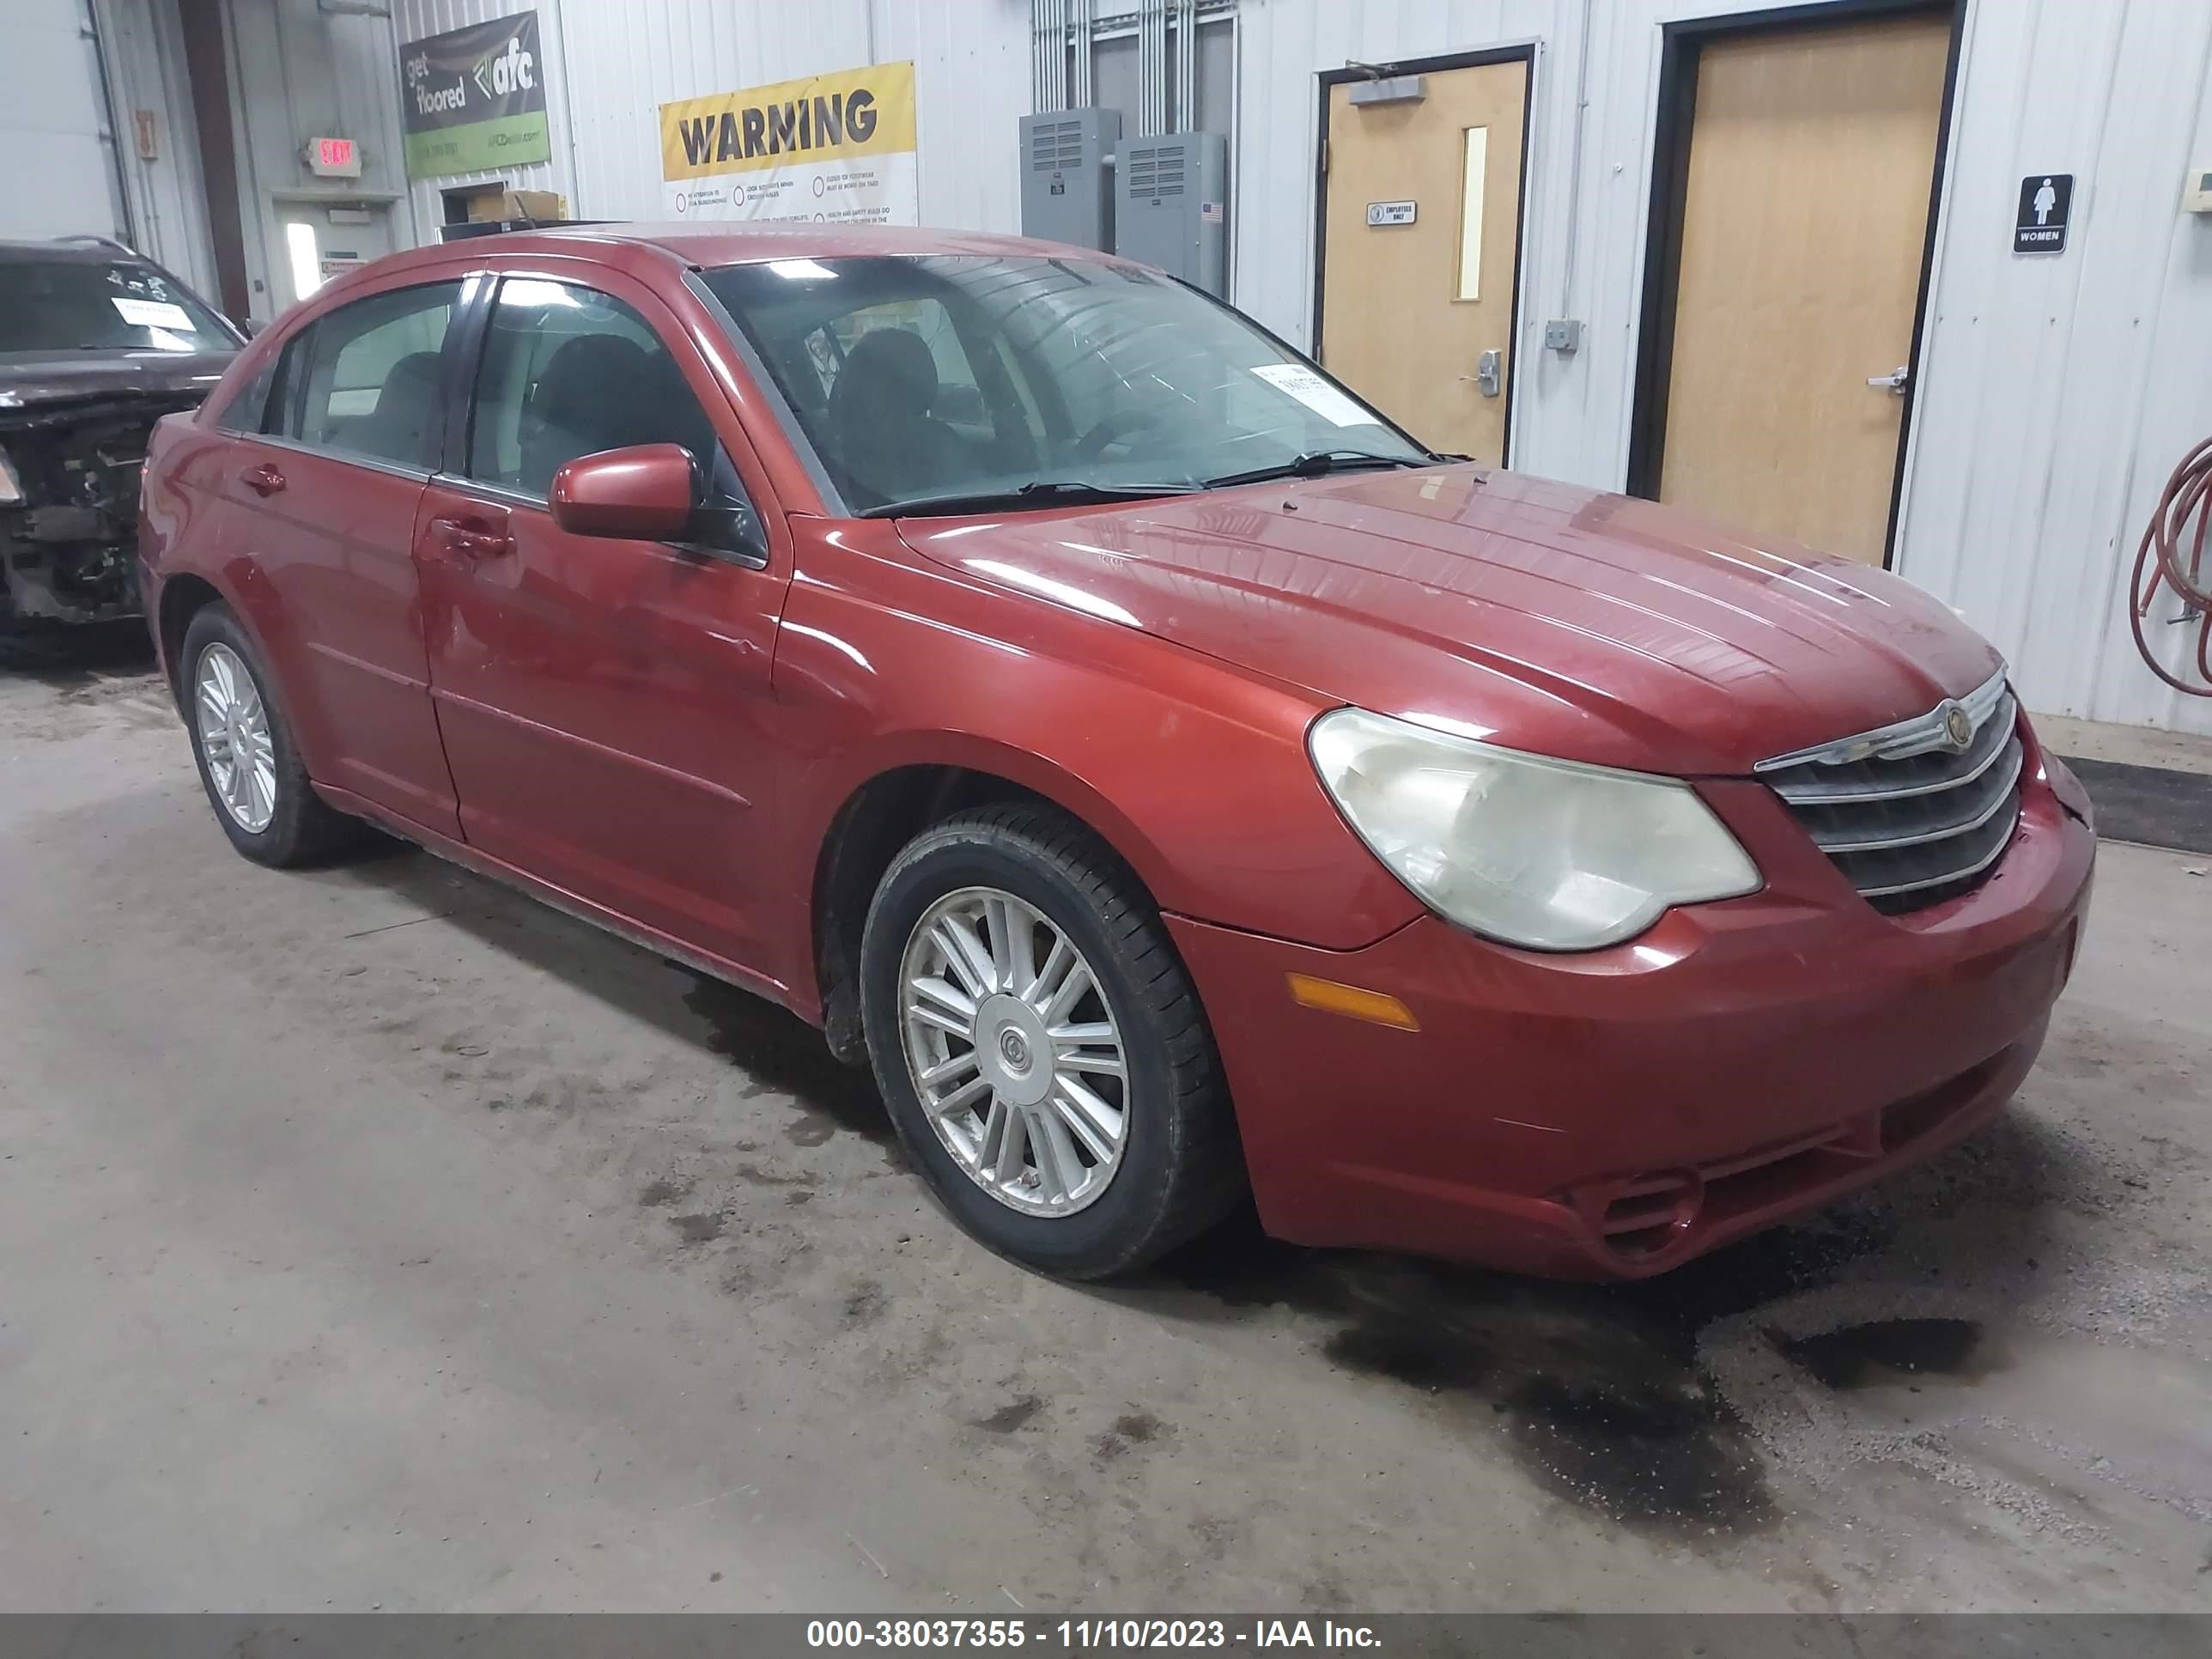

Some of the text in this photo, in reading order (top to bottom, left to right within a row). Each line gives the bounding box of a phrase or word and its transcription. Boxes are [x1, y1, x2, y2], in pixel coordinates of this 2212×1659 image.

[406, 51, 430, 86] get
[492, 37, 534, 95] afc
[416, 76, 466, 114] floored
[679, 88, 878, 167] WARNING
[2020, 231, 2059, 241] WOMEN
